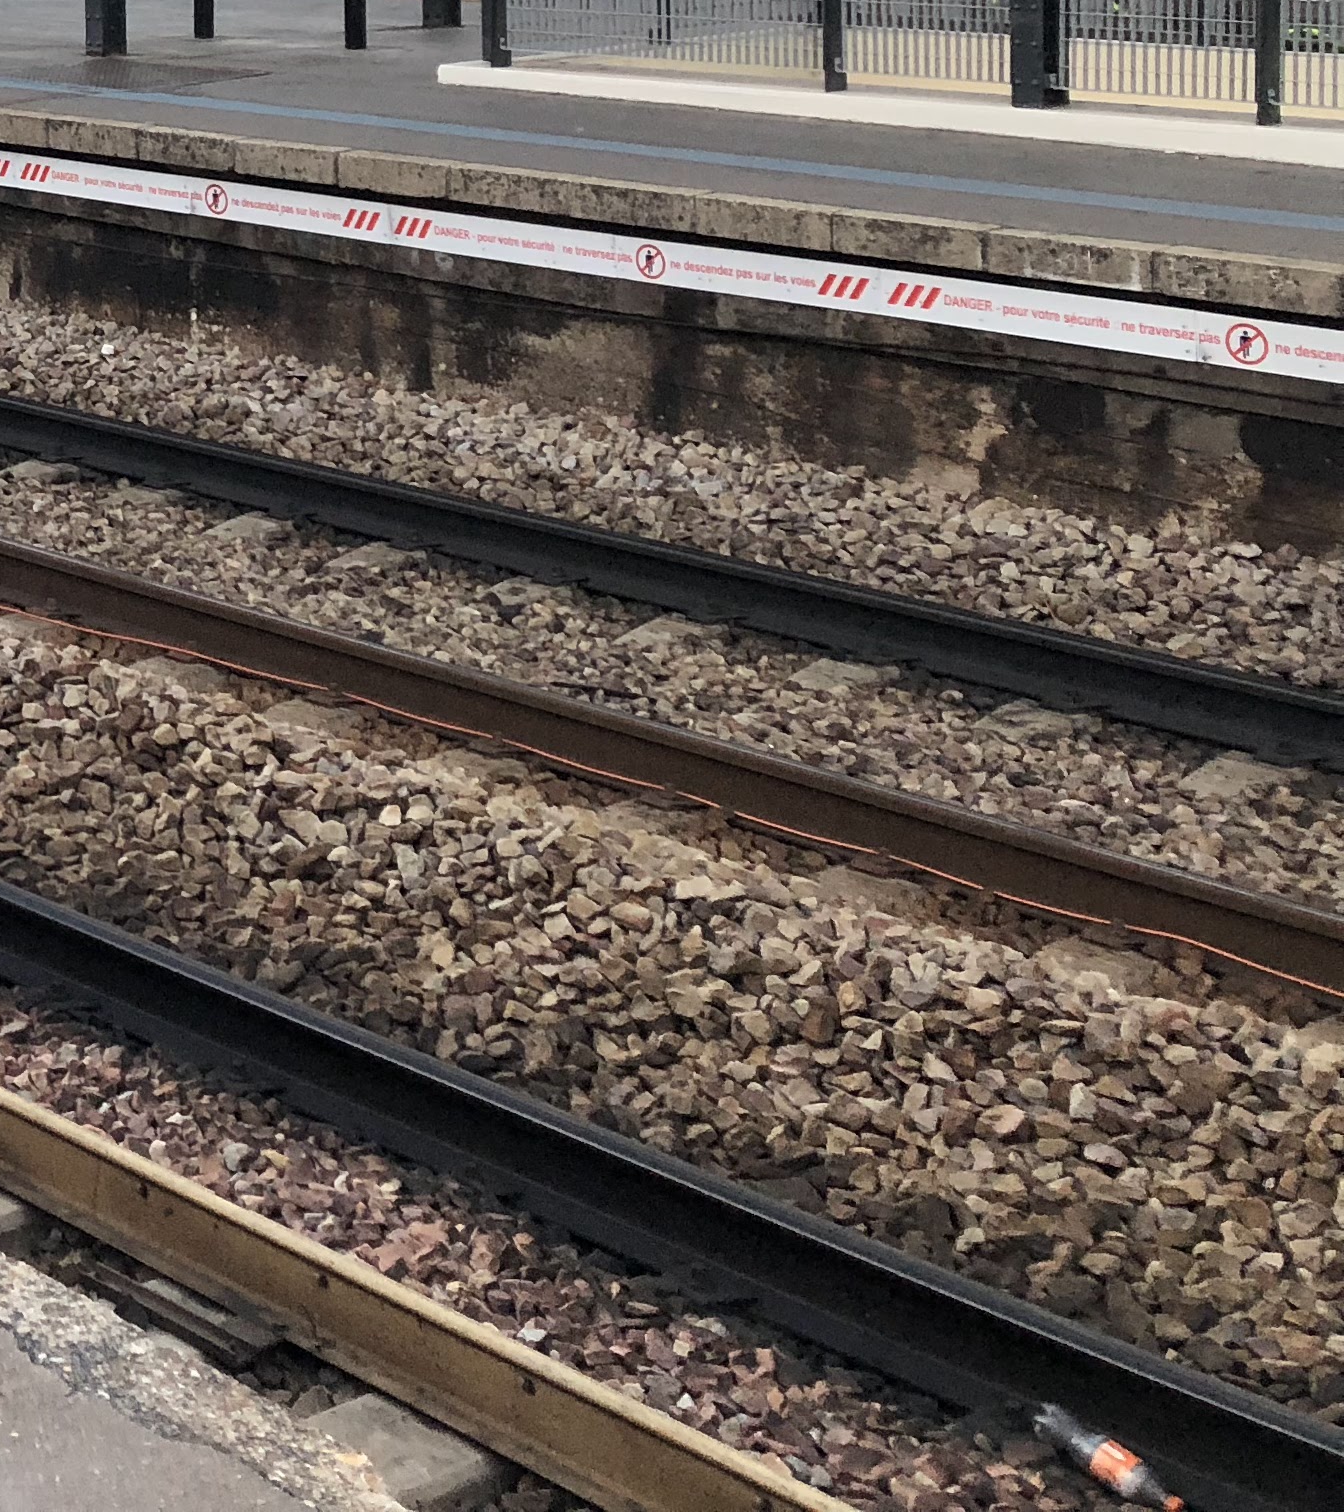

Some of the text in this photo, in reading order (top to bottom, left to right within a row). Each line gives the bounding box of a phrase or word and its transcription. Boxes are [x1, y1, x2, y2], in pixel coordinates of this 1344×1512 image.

[51, 168, 80, 184] DANGER
[231, 199, 342, 223] ne descendez pas sur les voies
[433, 225, 471, 240] DANGER
[477, 234, 497, 244] pour
[497, 236, 520, 246] votre
[562, 247, 574, 255] ne
[575, 247, 617, 262] traversez
[617, 253, 633, 264] pas
[669, 261, 817, 289] ne descendez pas sur les voies
[943, 294, 993, 312] DANGER
[1002, 305, 1029, 318] pour
[1031, 310, 1061, 322] votre
[1121, 322, 1136, 333] ne
[1139, 323, 1195, 342] traversez
[1198, 332, 1221, 346] pas
[1275, 344, 1344, 363] ne descen
